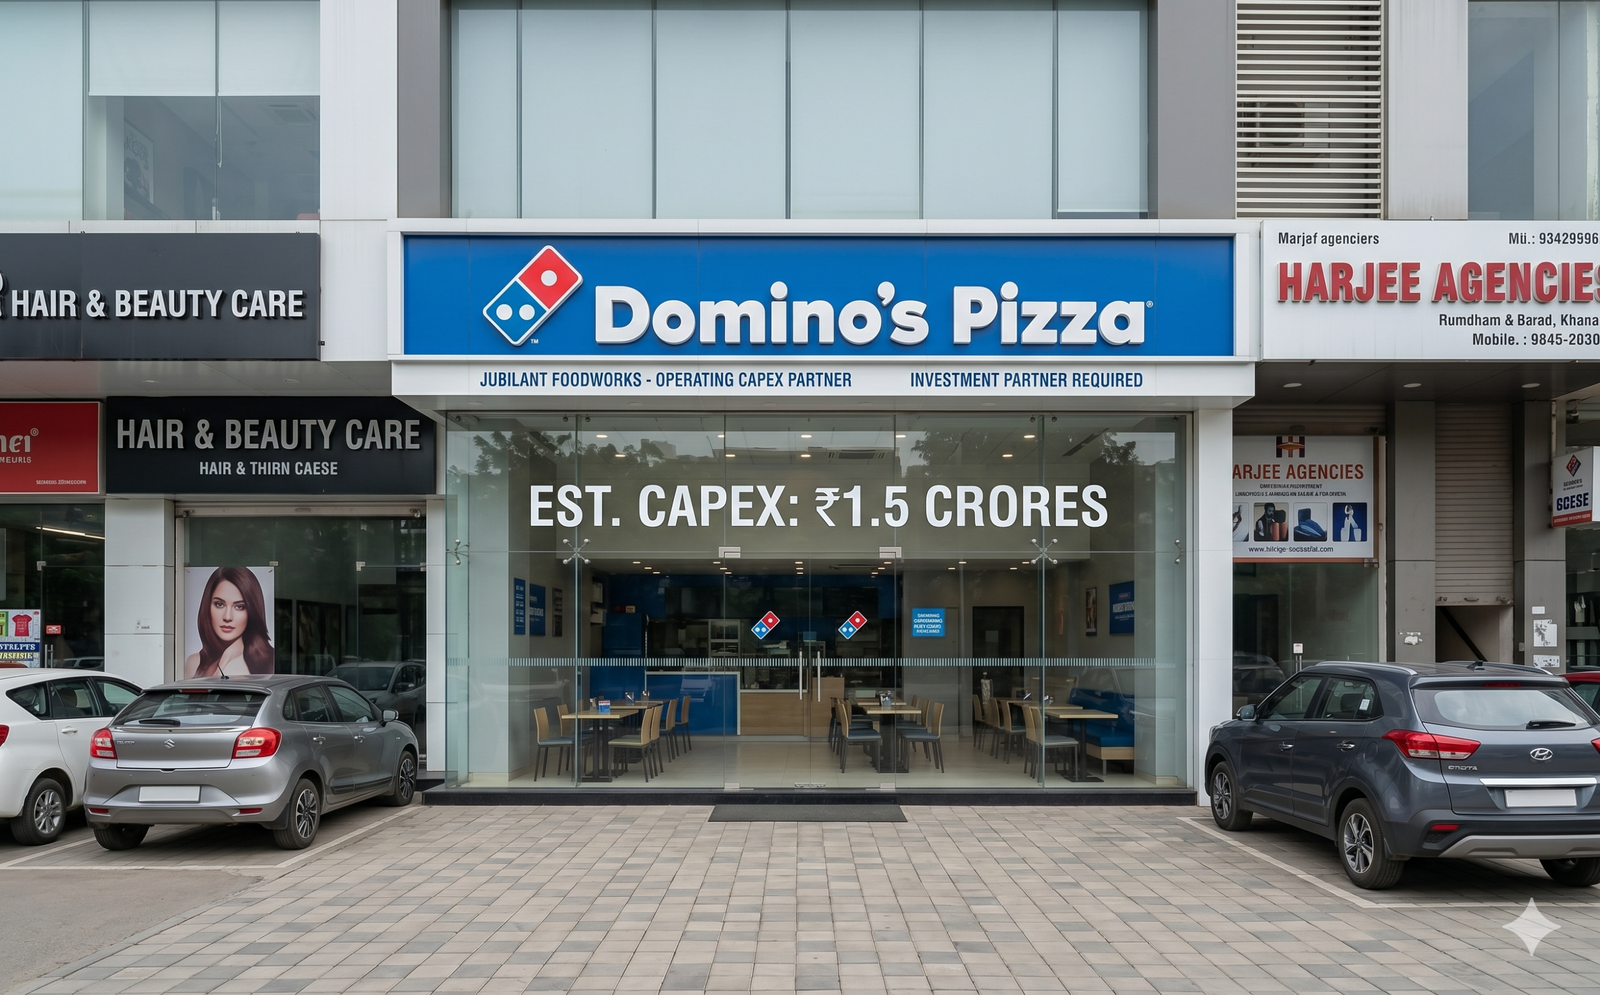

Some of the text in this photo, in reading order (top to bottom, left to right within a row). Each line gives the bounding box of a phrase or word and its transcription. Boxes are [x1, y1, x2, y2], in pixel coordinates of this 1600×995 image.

[1321, 232, 1380, 247] agenciers
[1277, 261, 1600, 304] HARJEE AGENCIE
[11, 289, 77, 317] HAIR
[86, 289, 106, 318] &
[115, 289, 223, 318] BEAUTY
[231, 289, 304, 318] CARE
[595, 281, 929, 345] Domino's
[1439, 314, 1599, 329] Rumdham & Barad, Khana
[1472, 333, 1519, 346] Mobile.
[480, 372, 548, 388] JUBILANT
[552, 372, 642, 388] FOODWORKS
[655, 372, 734, 388] OPERATING
[738, 372, 784, 388] CAPEX
[788, 372, 852, 388] PARTNER
[910, 372, 1143, 388] INVESTMENT PARTNER REQUIRED
[117, 419, 421, 450] HAIR & BEAUTY CARE
[199, 461, 338, 476] HAIR & THIRN CAESE
[1233, 463, 1364, 480] ARJEE AGENCIES
[529, 484, 1109, 528] EST. CAPEX: ₹1.5 CRORES
